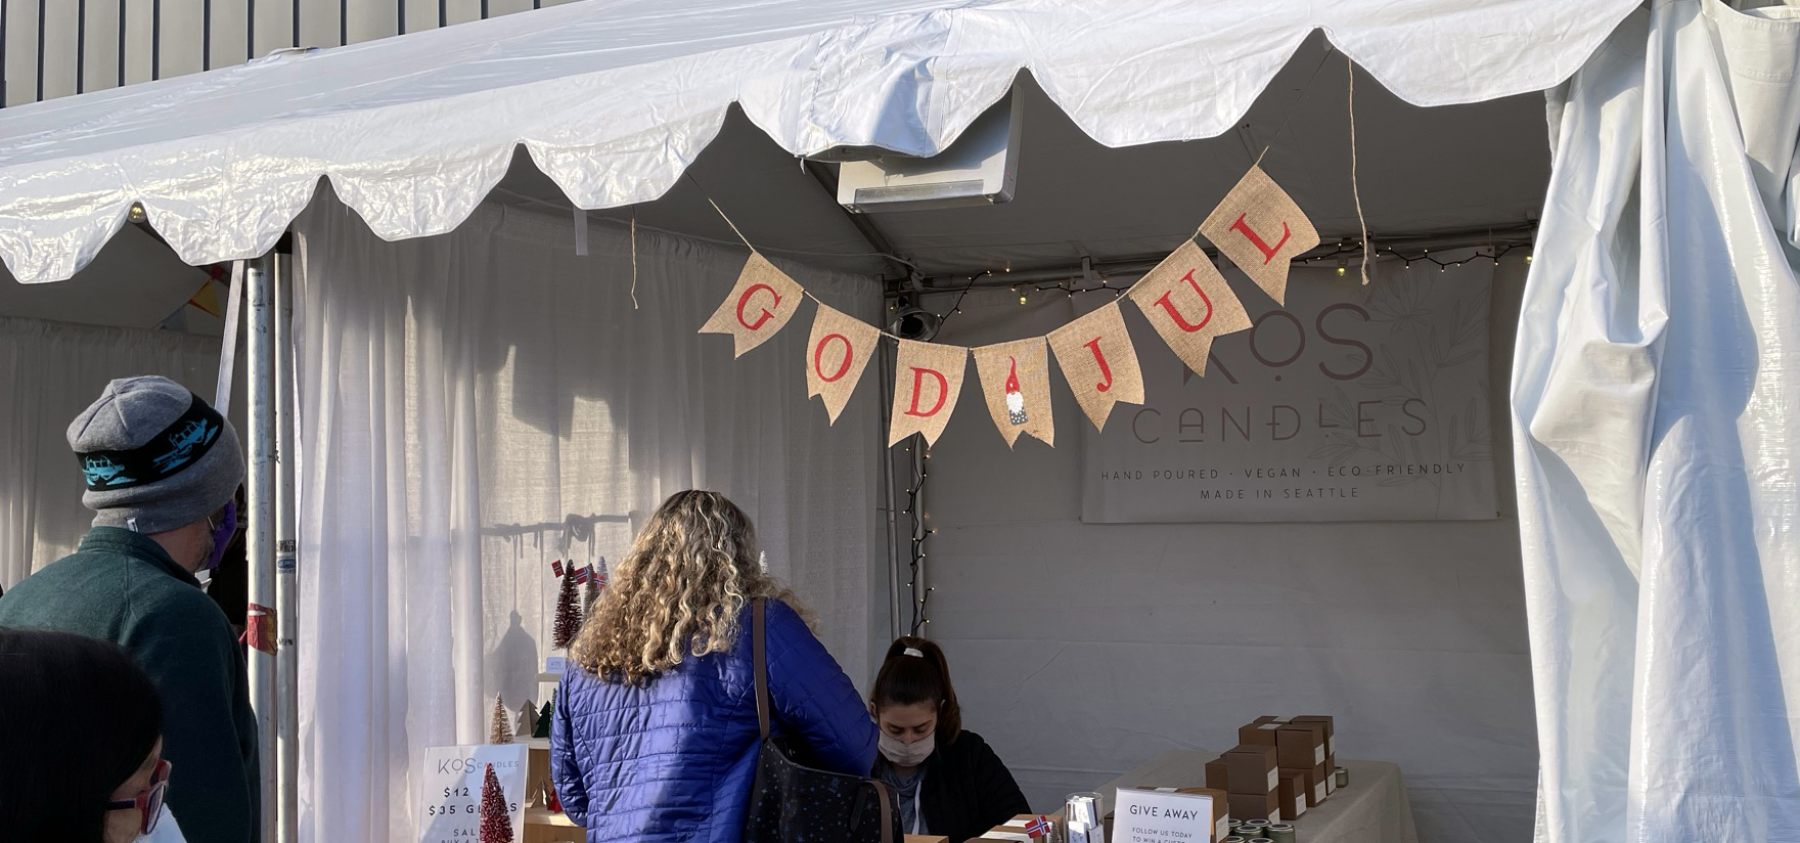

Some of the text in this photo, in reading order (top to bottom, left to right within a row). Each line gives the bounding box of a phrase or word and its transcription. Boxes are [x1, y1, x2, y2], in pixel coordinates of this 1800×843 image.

[736, 213, 1292, 418] GOD JUL
[1132, 398, 1428, 445] CANDLES
[1101, 470, 1143, 480] HAND
[1153, 469, 1218, 480] POURED
[1244, 468, 1300, 478] VEGAN
[1200, 487, 1358, 499] MADE IN SEATTLE
[444, 787, 469, 798] $12
[429, 804, 456, 816] $35
[1129, 805, 1198, 820] GIVE AWAY
[1132, 827, 1158, 835] FOLLOW
